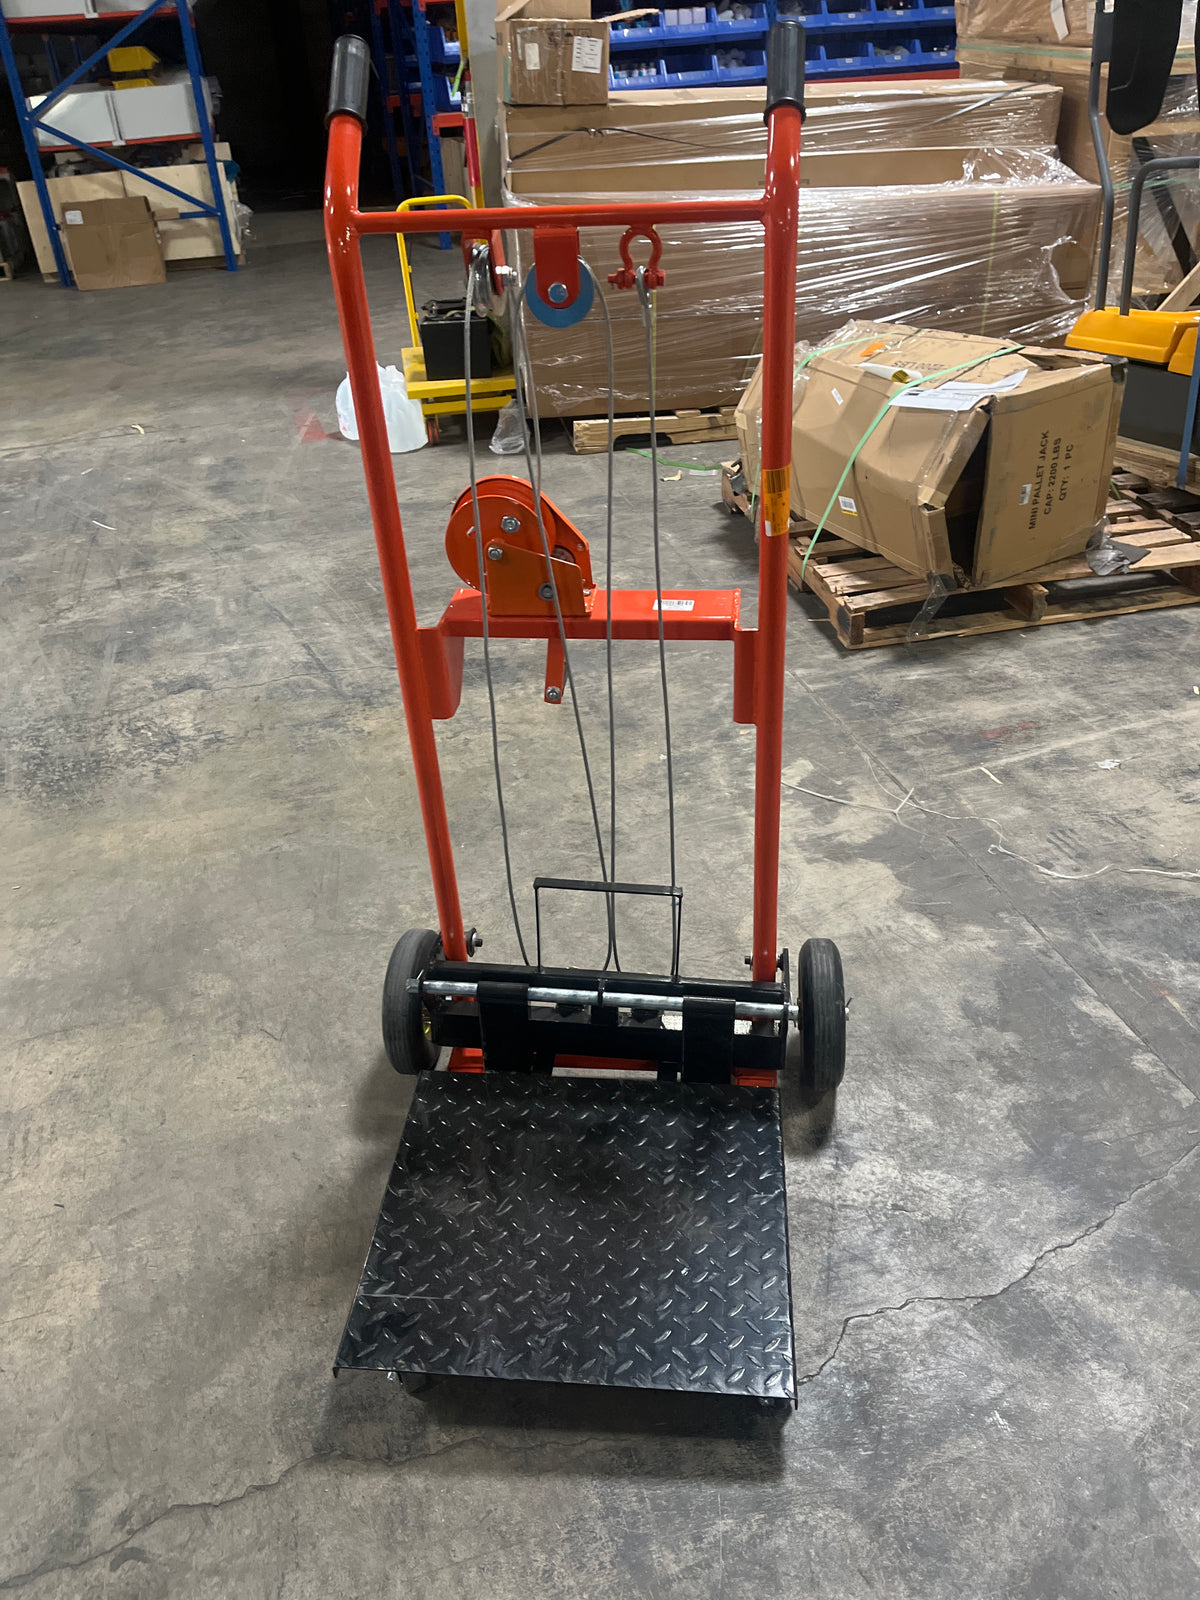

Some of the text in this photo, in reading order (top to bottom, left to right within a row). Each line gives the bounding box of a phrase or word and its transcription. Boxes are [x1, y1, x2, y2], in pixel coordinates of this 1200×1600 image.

[1052, 437, 1062, 461] LBS
[1065, 444, 1074, 460] PC
[1028, 430, 1049, 530] MINI PALLET JACK
[1048, 462, 1058, 487] 2200
